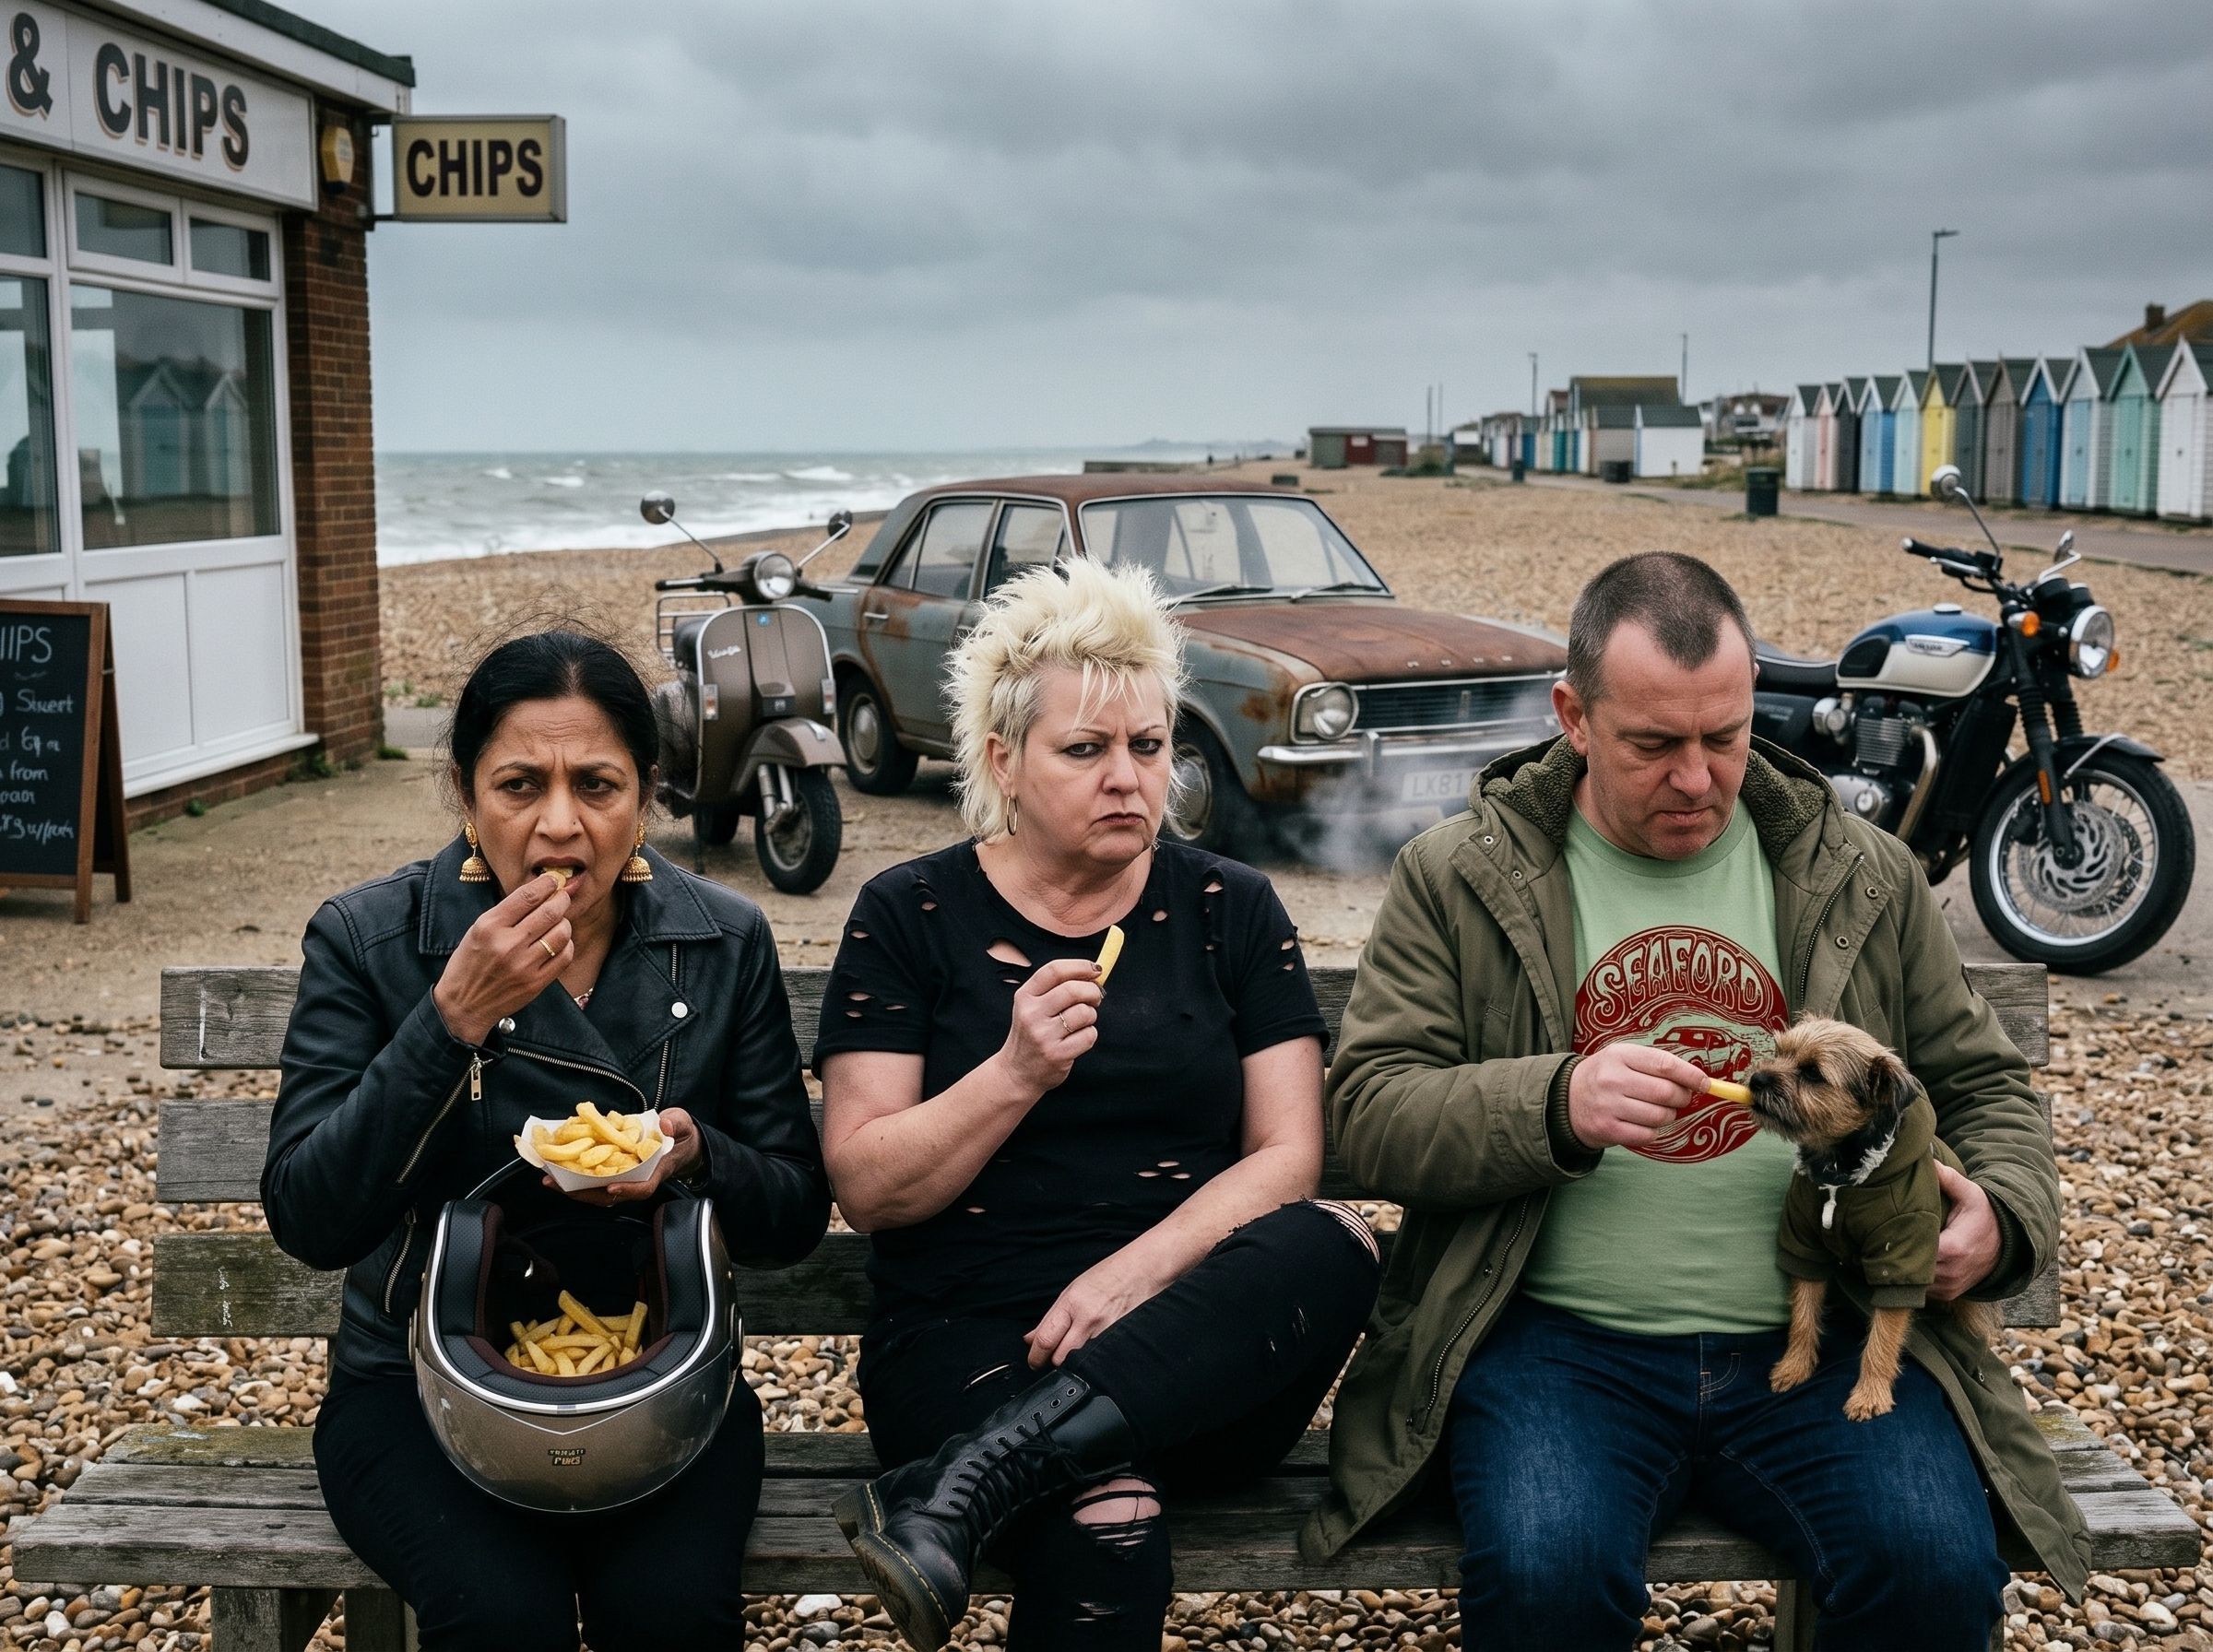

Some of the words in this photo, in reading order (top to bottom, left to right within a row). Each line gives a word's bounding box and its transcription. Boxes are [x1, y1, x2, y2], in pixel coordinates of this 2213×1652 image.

[6, 12, 53, 120] &
[95, 42, 249, 171] CHIPS
[406, 138, 544, 198] CHIPS
[1592, 935, 1765, 1025] SEAFORD
